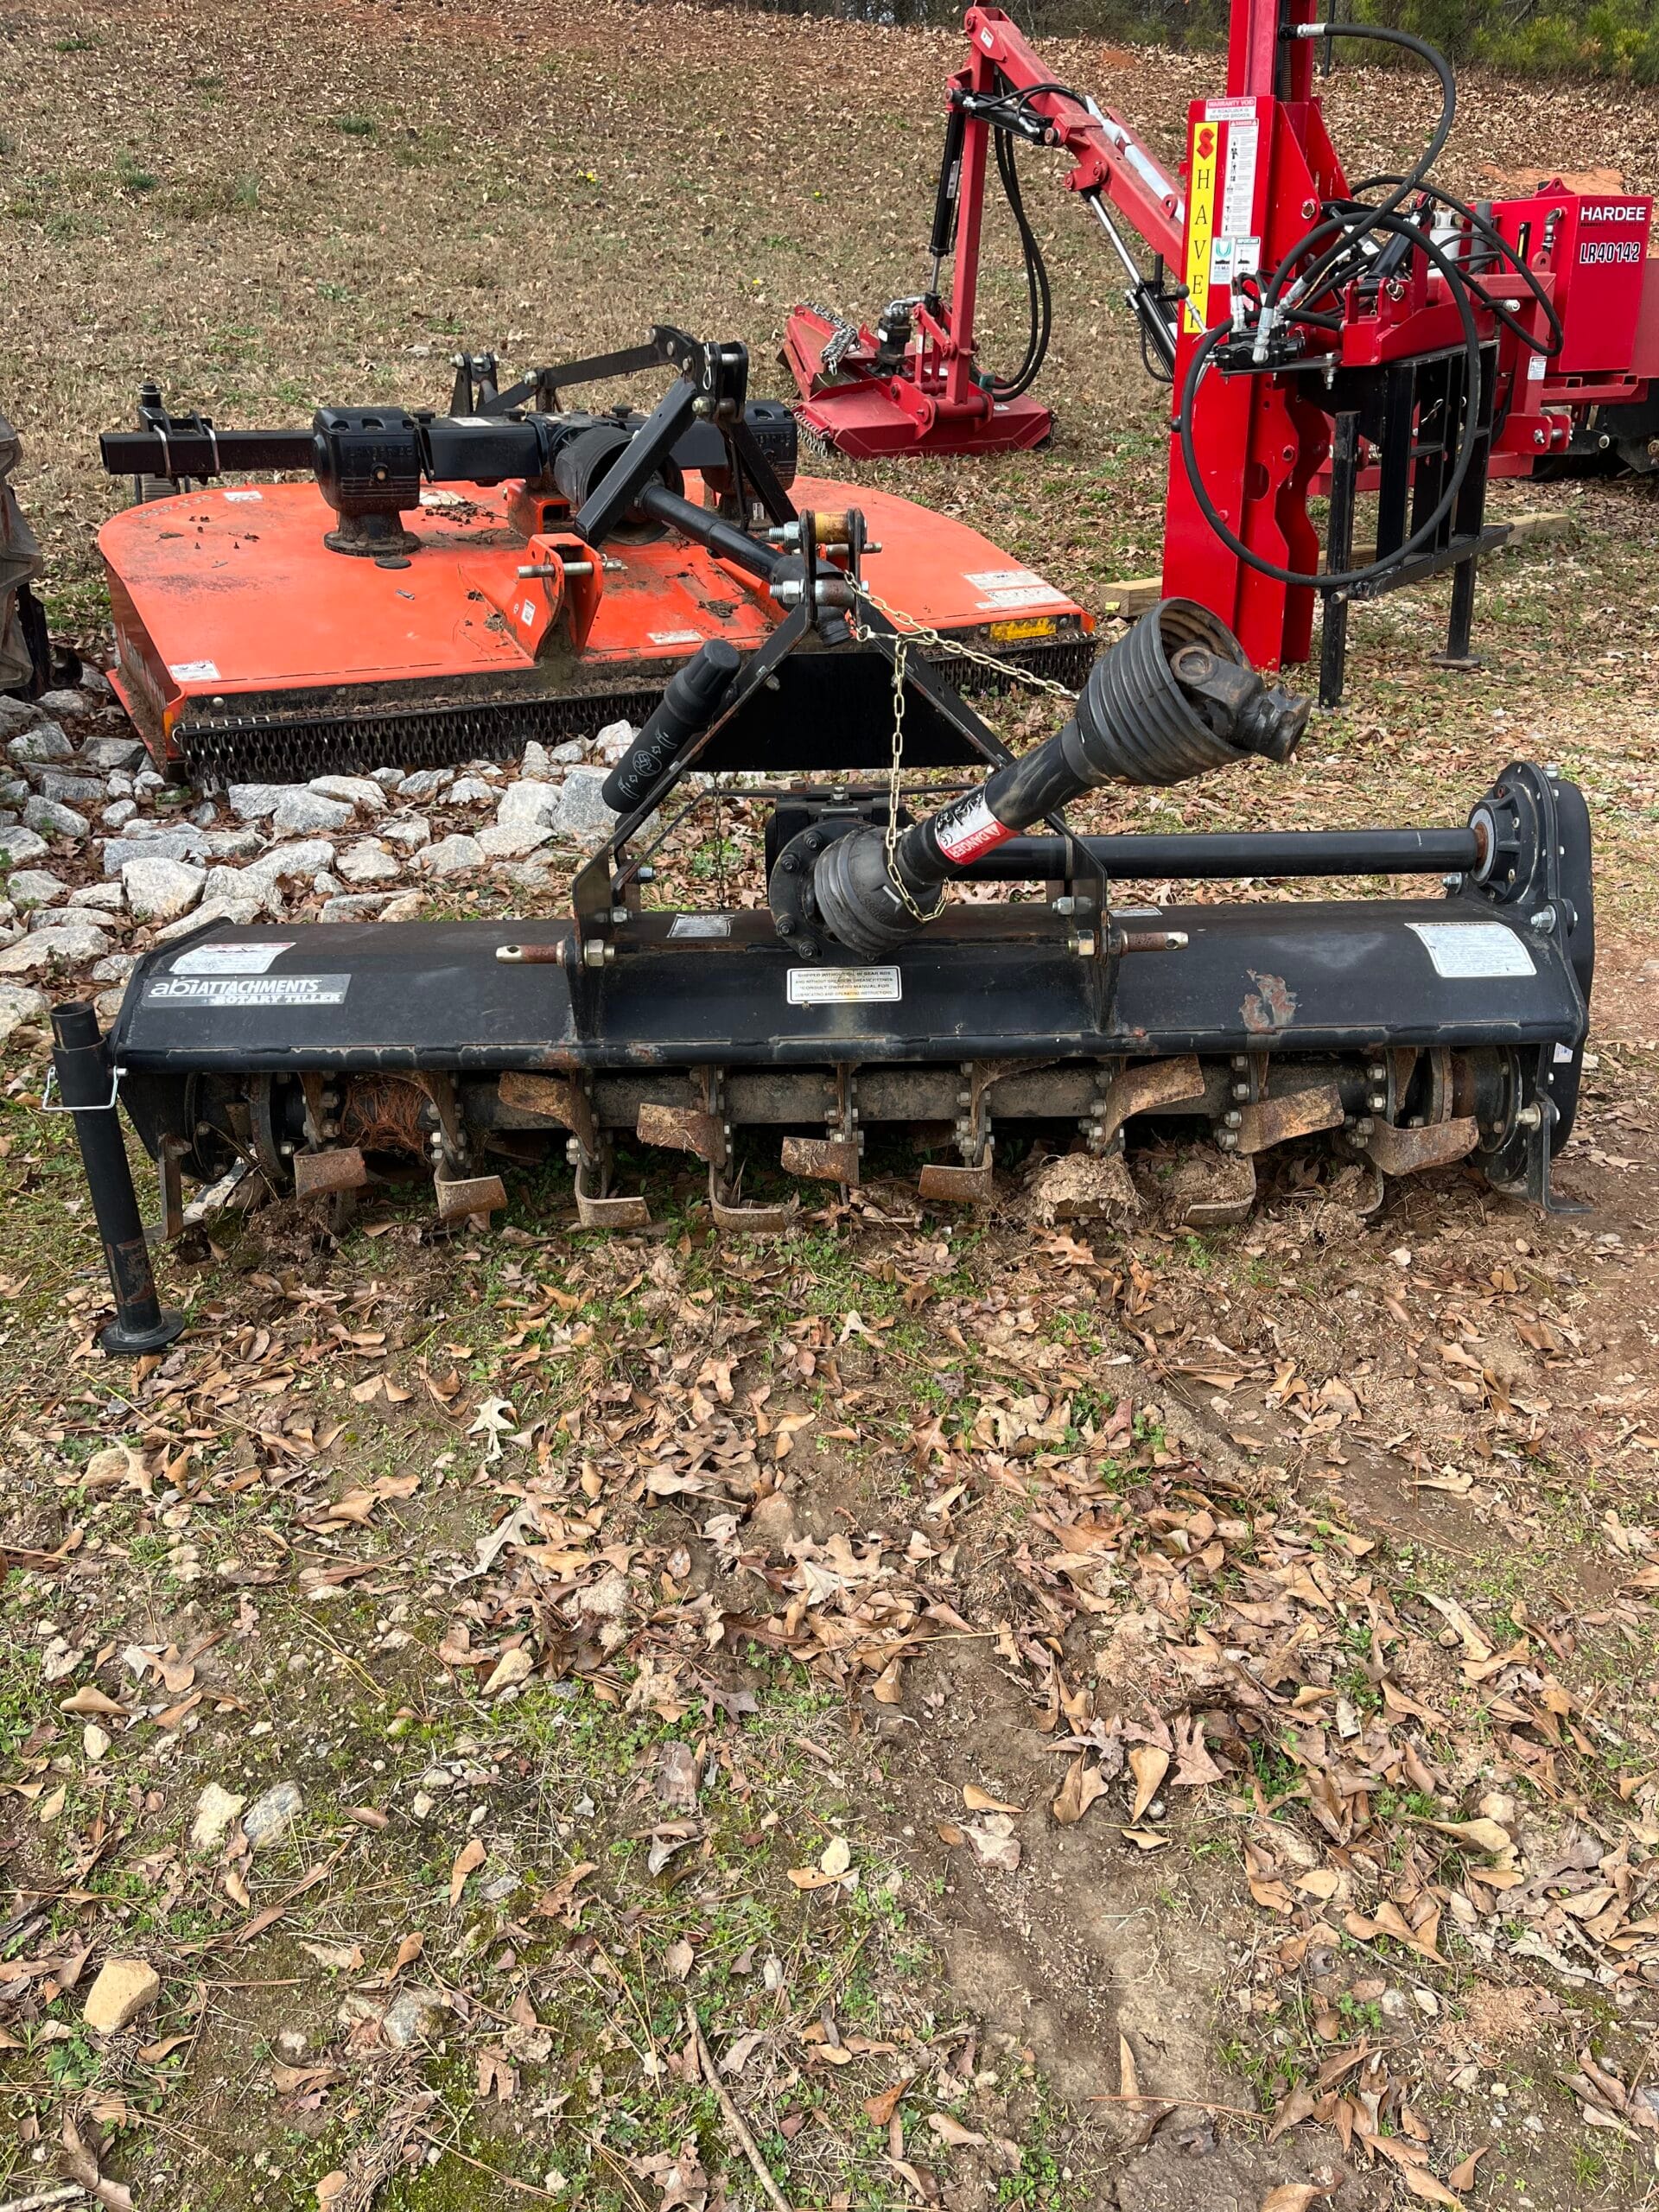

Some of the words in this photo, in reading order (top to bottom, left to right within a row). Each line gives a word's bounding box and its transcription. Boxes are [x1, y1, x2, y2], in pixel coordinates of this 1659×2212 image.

[1580, 207, 1646, 221] HARDEE
[1580, 242, 1641, 264] LR40142
[947, 833, 991, 858] DANGER
[213, 995, 282, 1005] ROTARY
[284, 995, 340, 1003] TILLER
